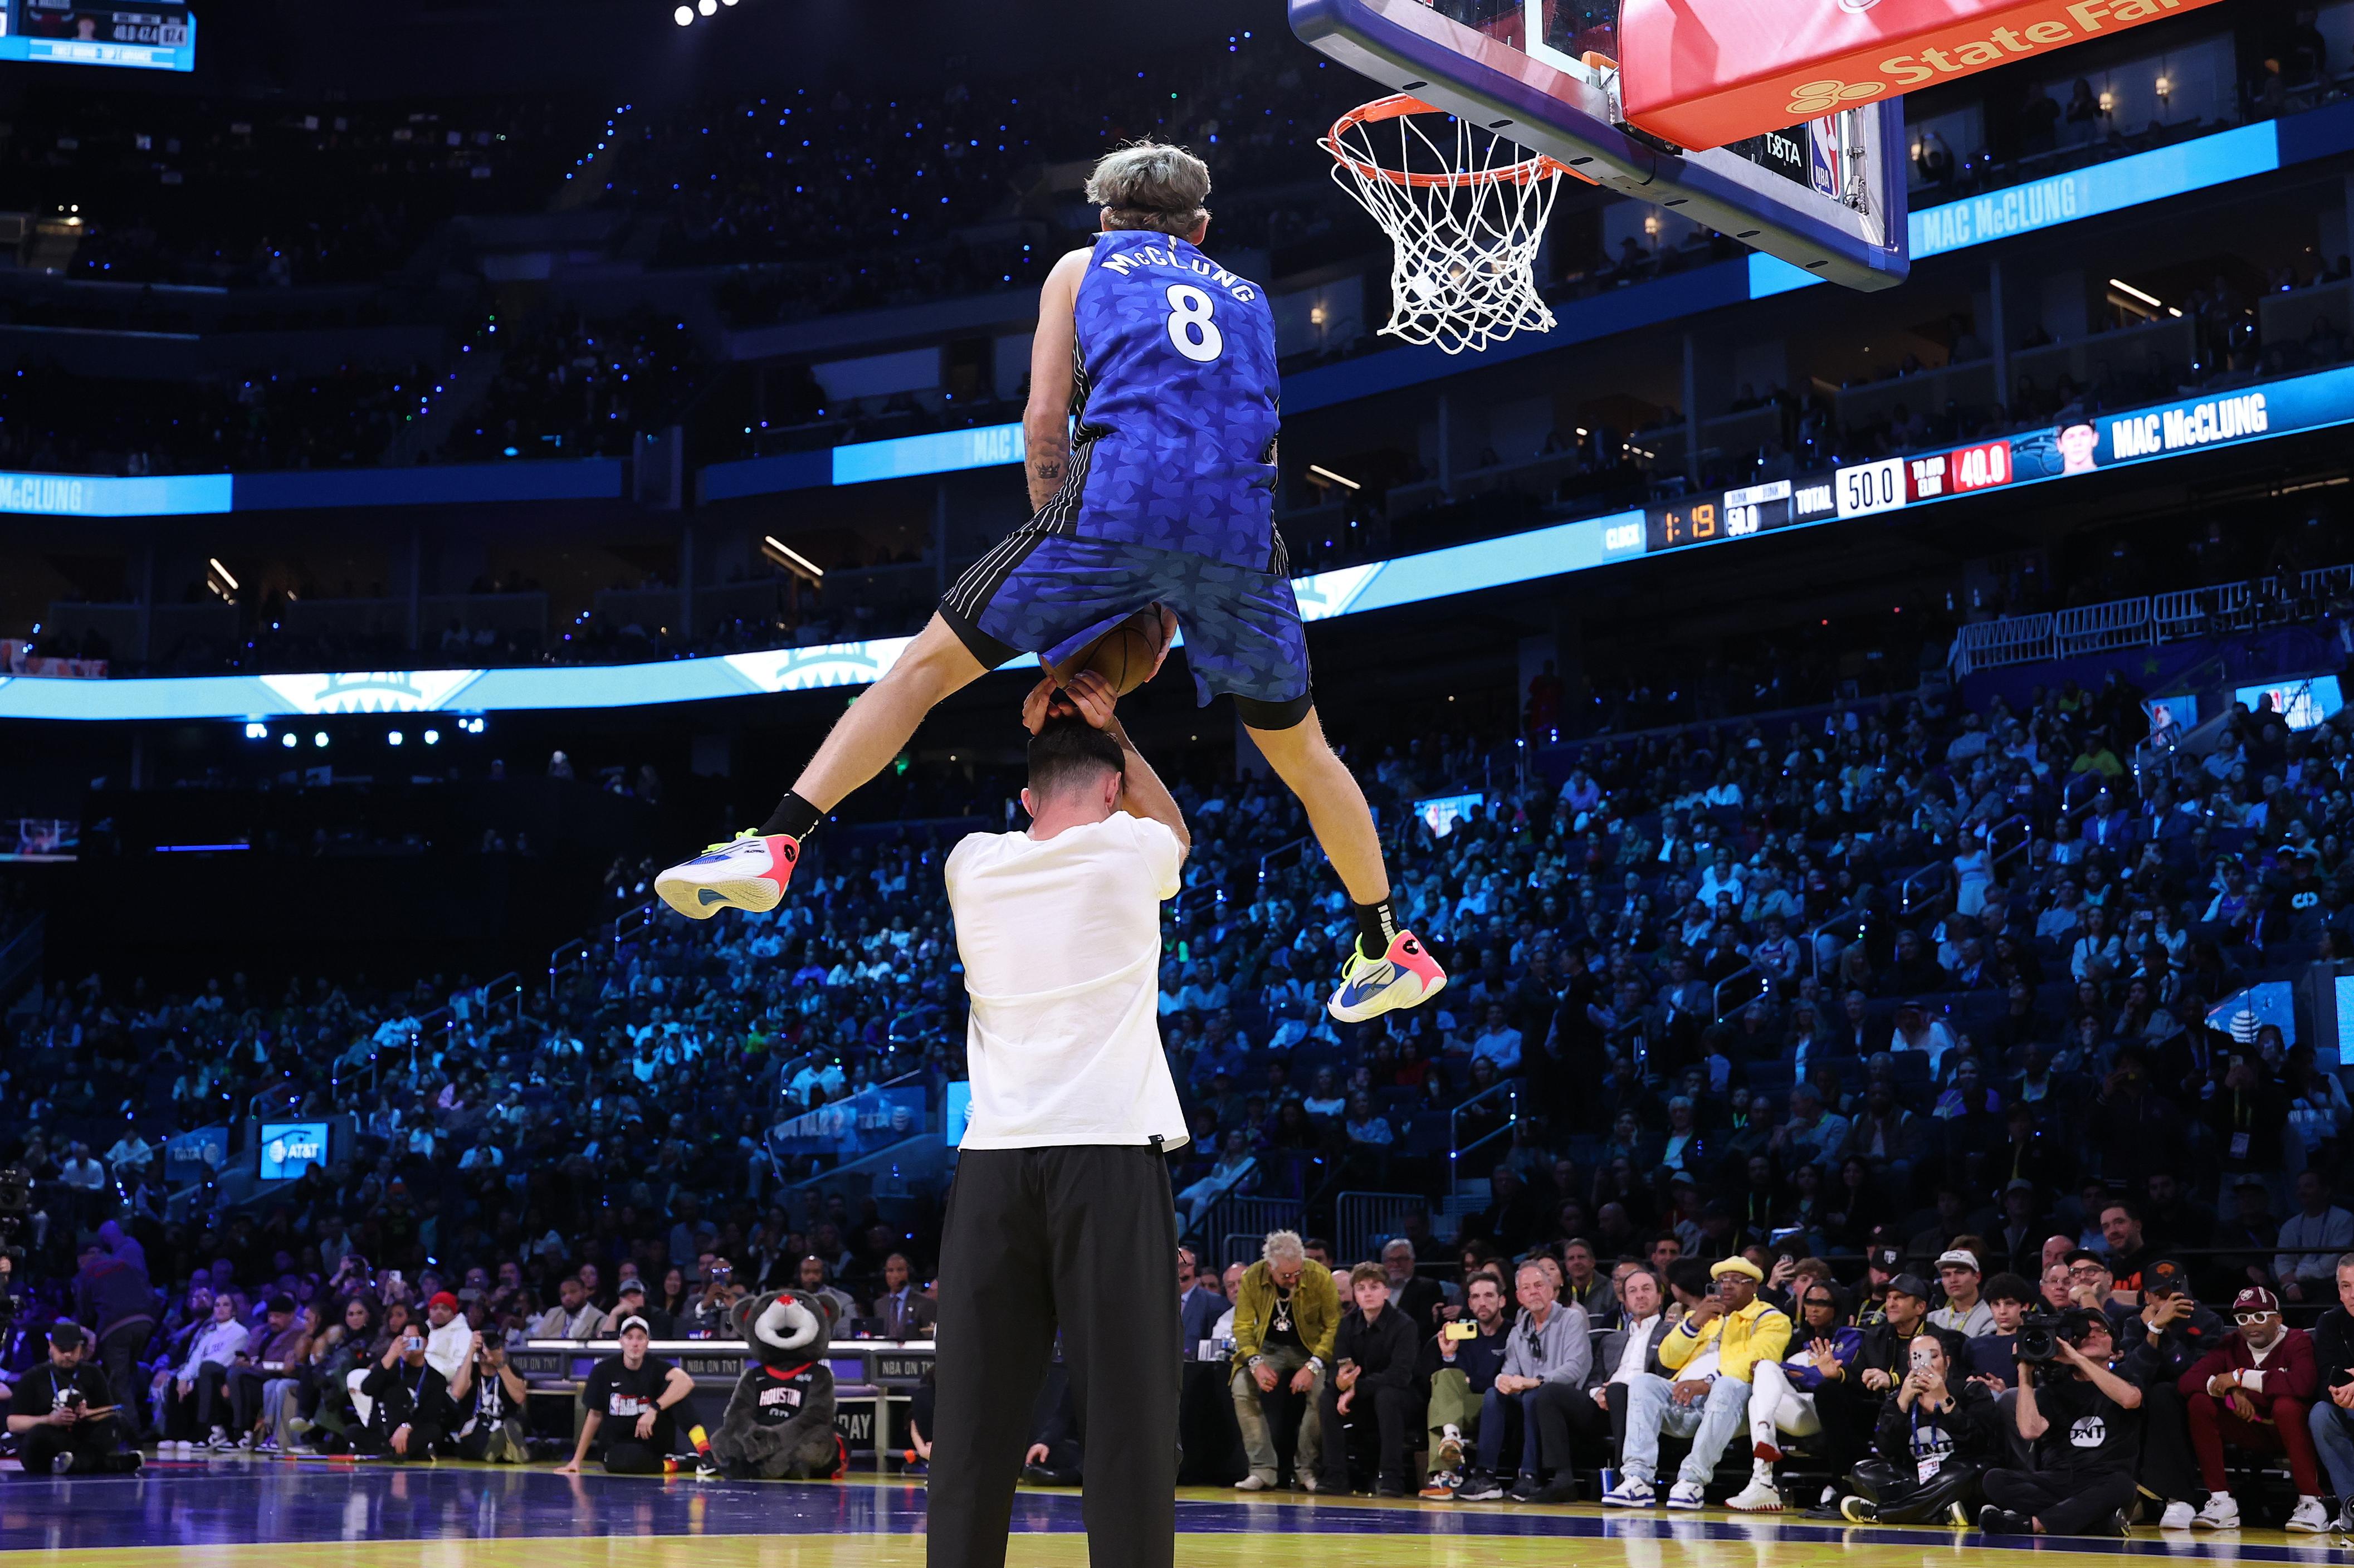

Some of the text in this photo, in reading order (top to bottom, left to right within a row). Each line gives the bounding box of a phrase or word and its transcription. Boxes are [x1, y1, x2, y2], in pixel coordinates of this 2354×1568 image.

[1815, 165, 1830, 189] NBA
[1923, 177, 2076, 251] MAC McCLUNG
[1101, 246, 1255, 302] McCLUNG
[1165, 284, 1223, 363] 8
[2112, 393, 2268, 459] MAC McCLUNG
[974, 427, 1011, 462] MAC
[1960, 444, 2006, 487] 40.0
[1795, 485, 1834, 514] TOTAL
[1849, 468, 1893, 509] 50.0
[1727, 505, 1758, 536] 50.0
[287, 1143, 319, 1159] AT&T
[687, 1360, 737, 1372] NBA ON TNT
[882, 1361, 901, 1375] NBA
[905, 1361, 918, 1375] ON
